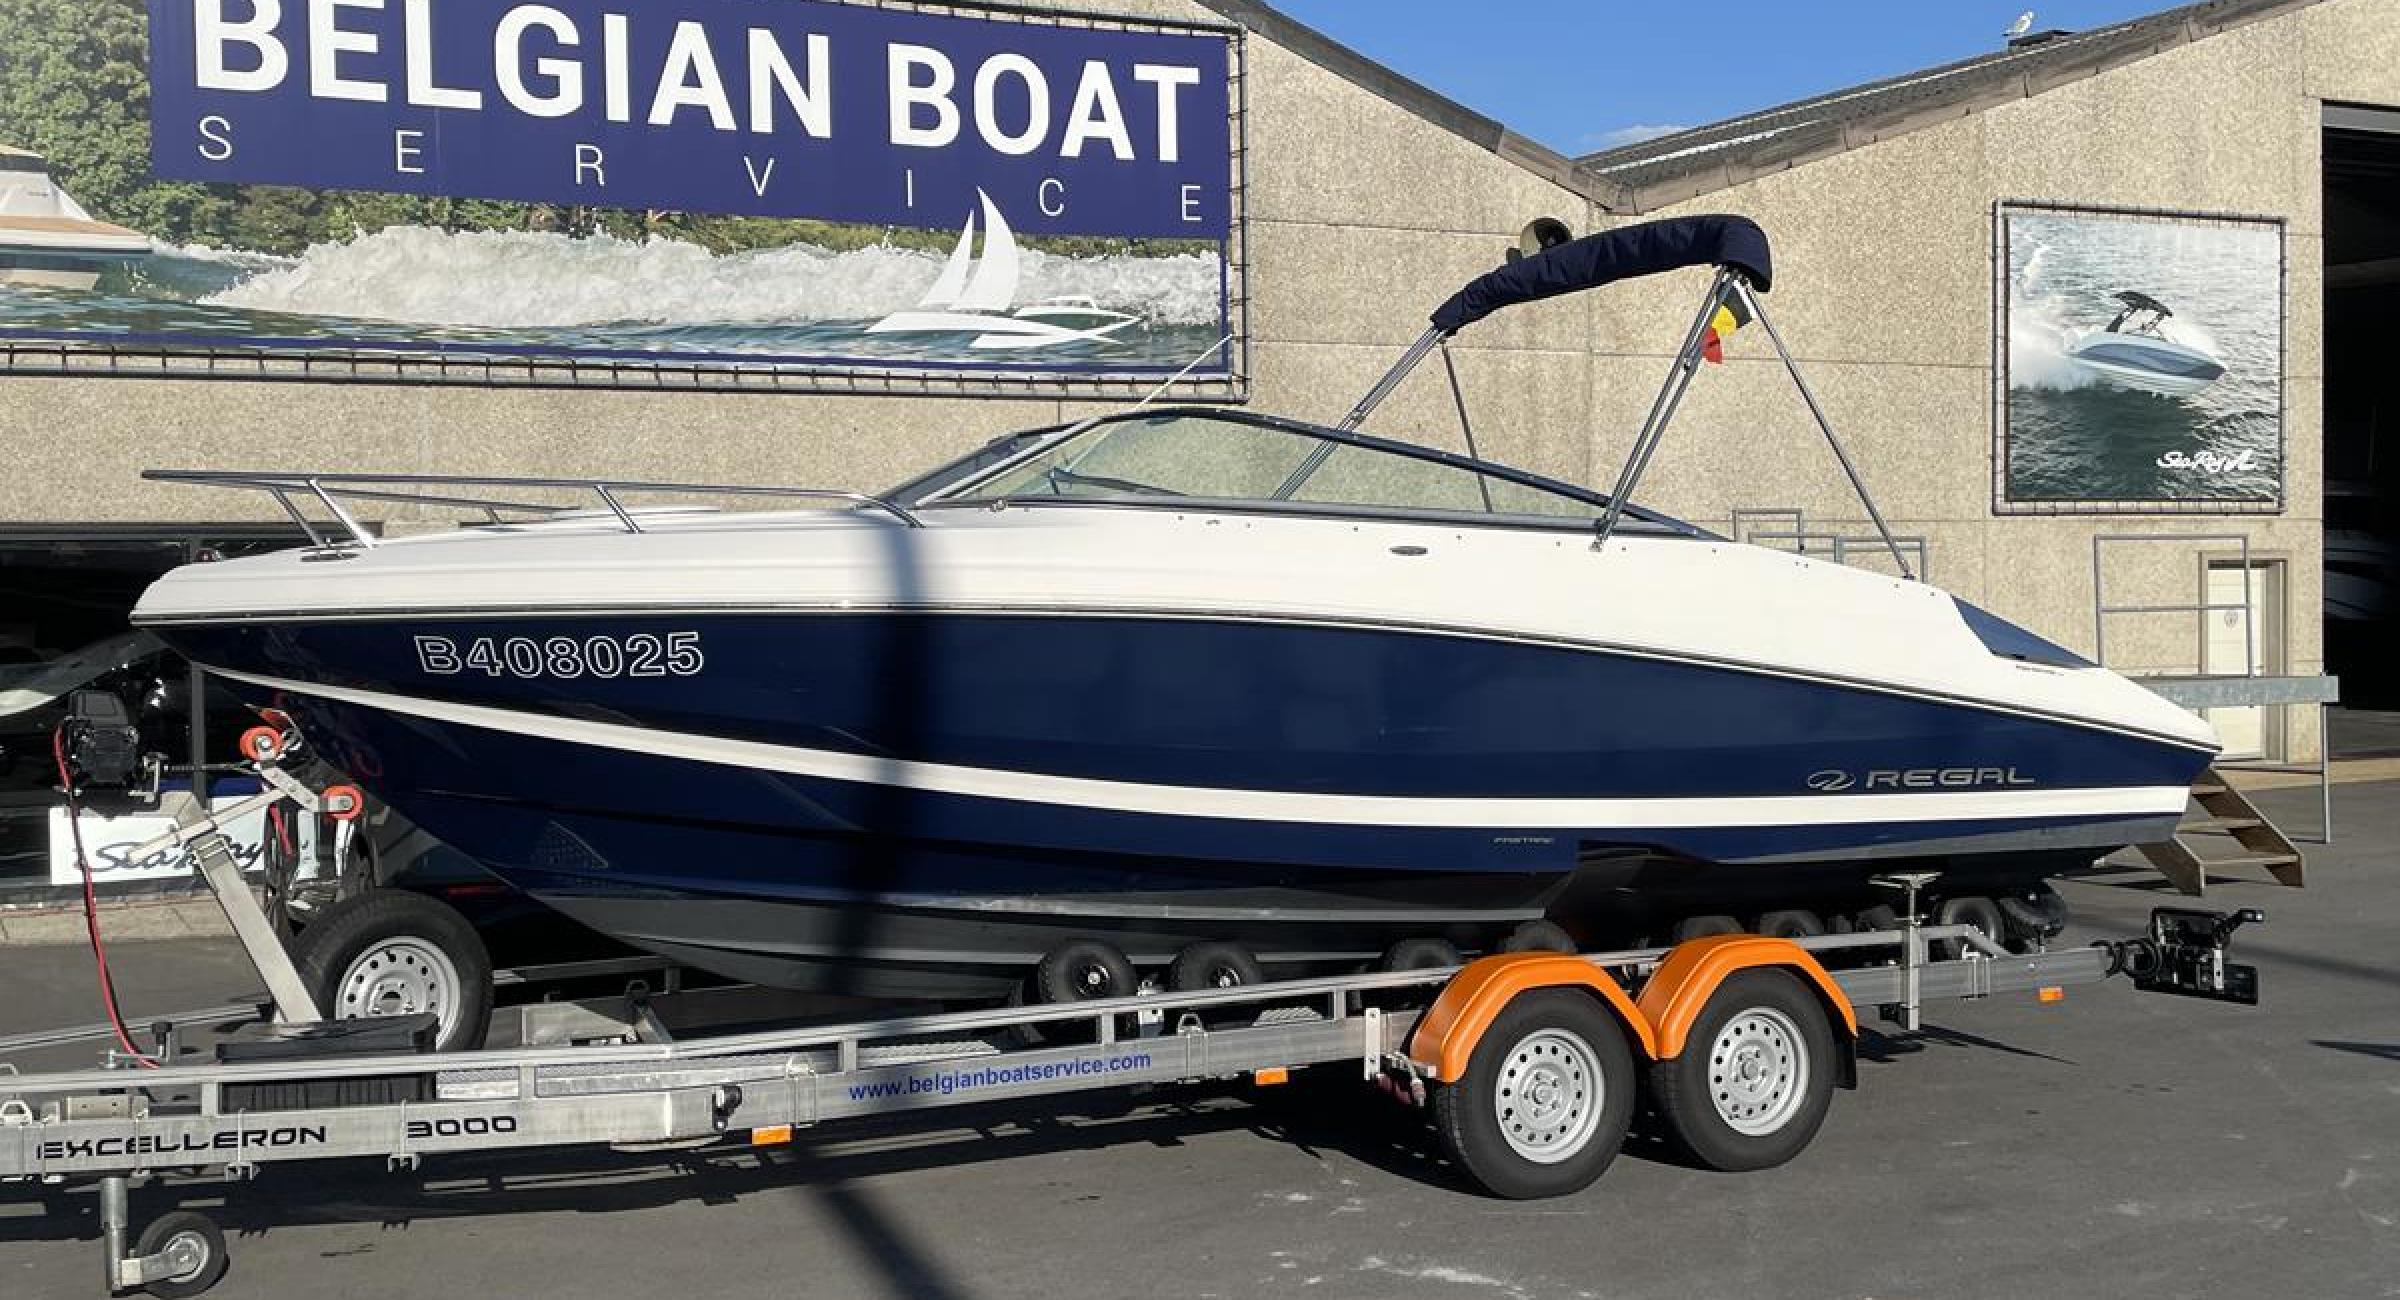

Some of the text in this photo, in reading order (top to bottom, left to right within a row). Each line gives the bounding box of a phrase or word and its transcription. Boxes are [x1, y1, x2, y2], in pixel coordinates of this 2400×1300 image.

[194, 0, 1200, 163] BELGIAN BOAT
[414, 631, 704, 679] B408025
[1865, 767, 2036, 789] REGAL
[849, 1052, 1151, 1101] www.belgianboatservice.com
[37, 1115, 517, 1160] EXCELLERON 3000
